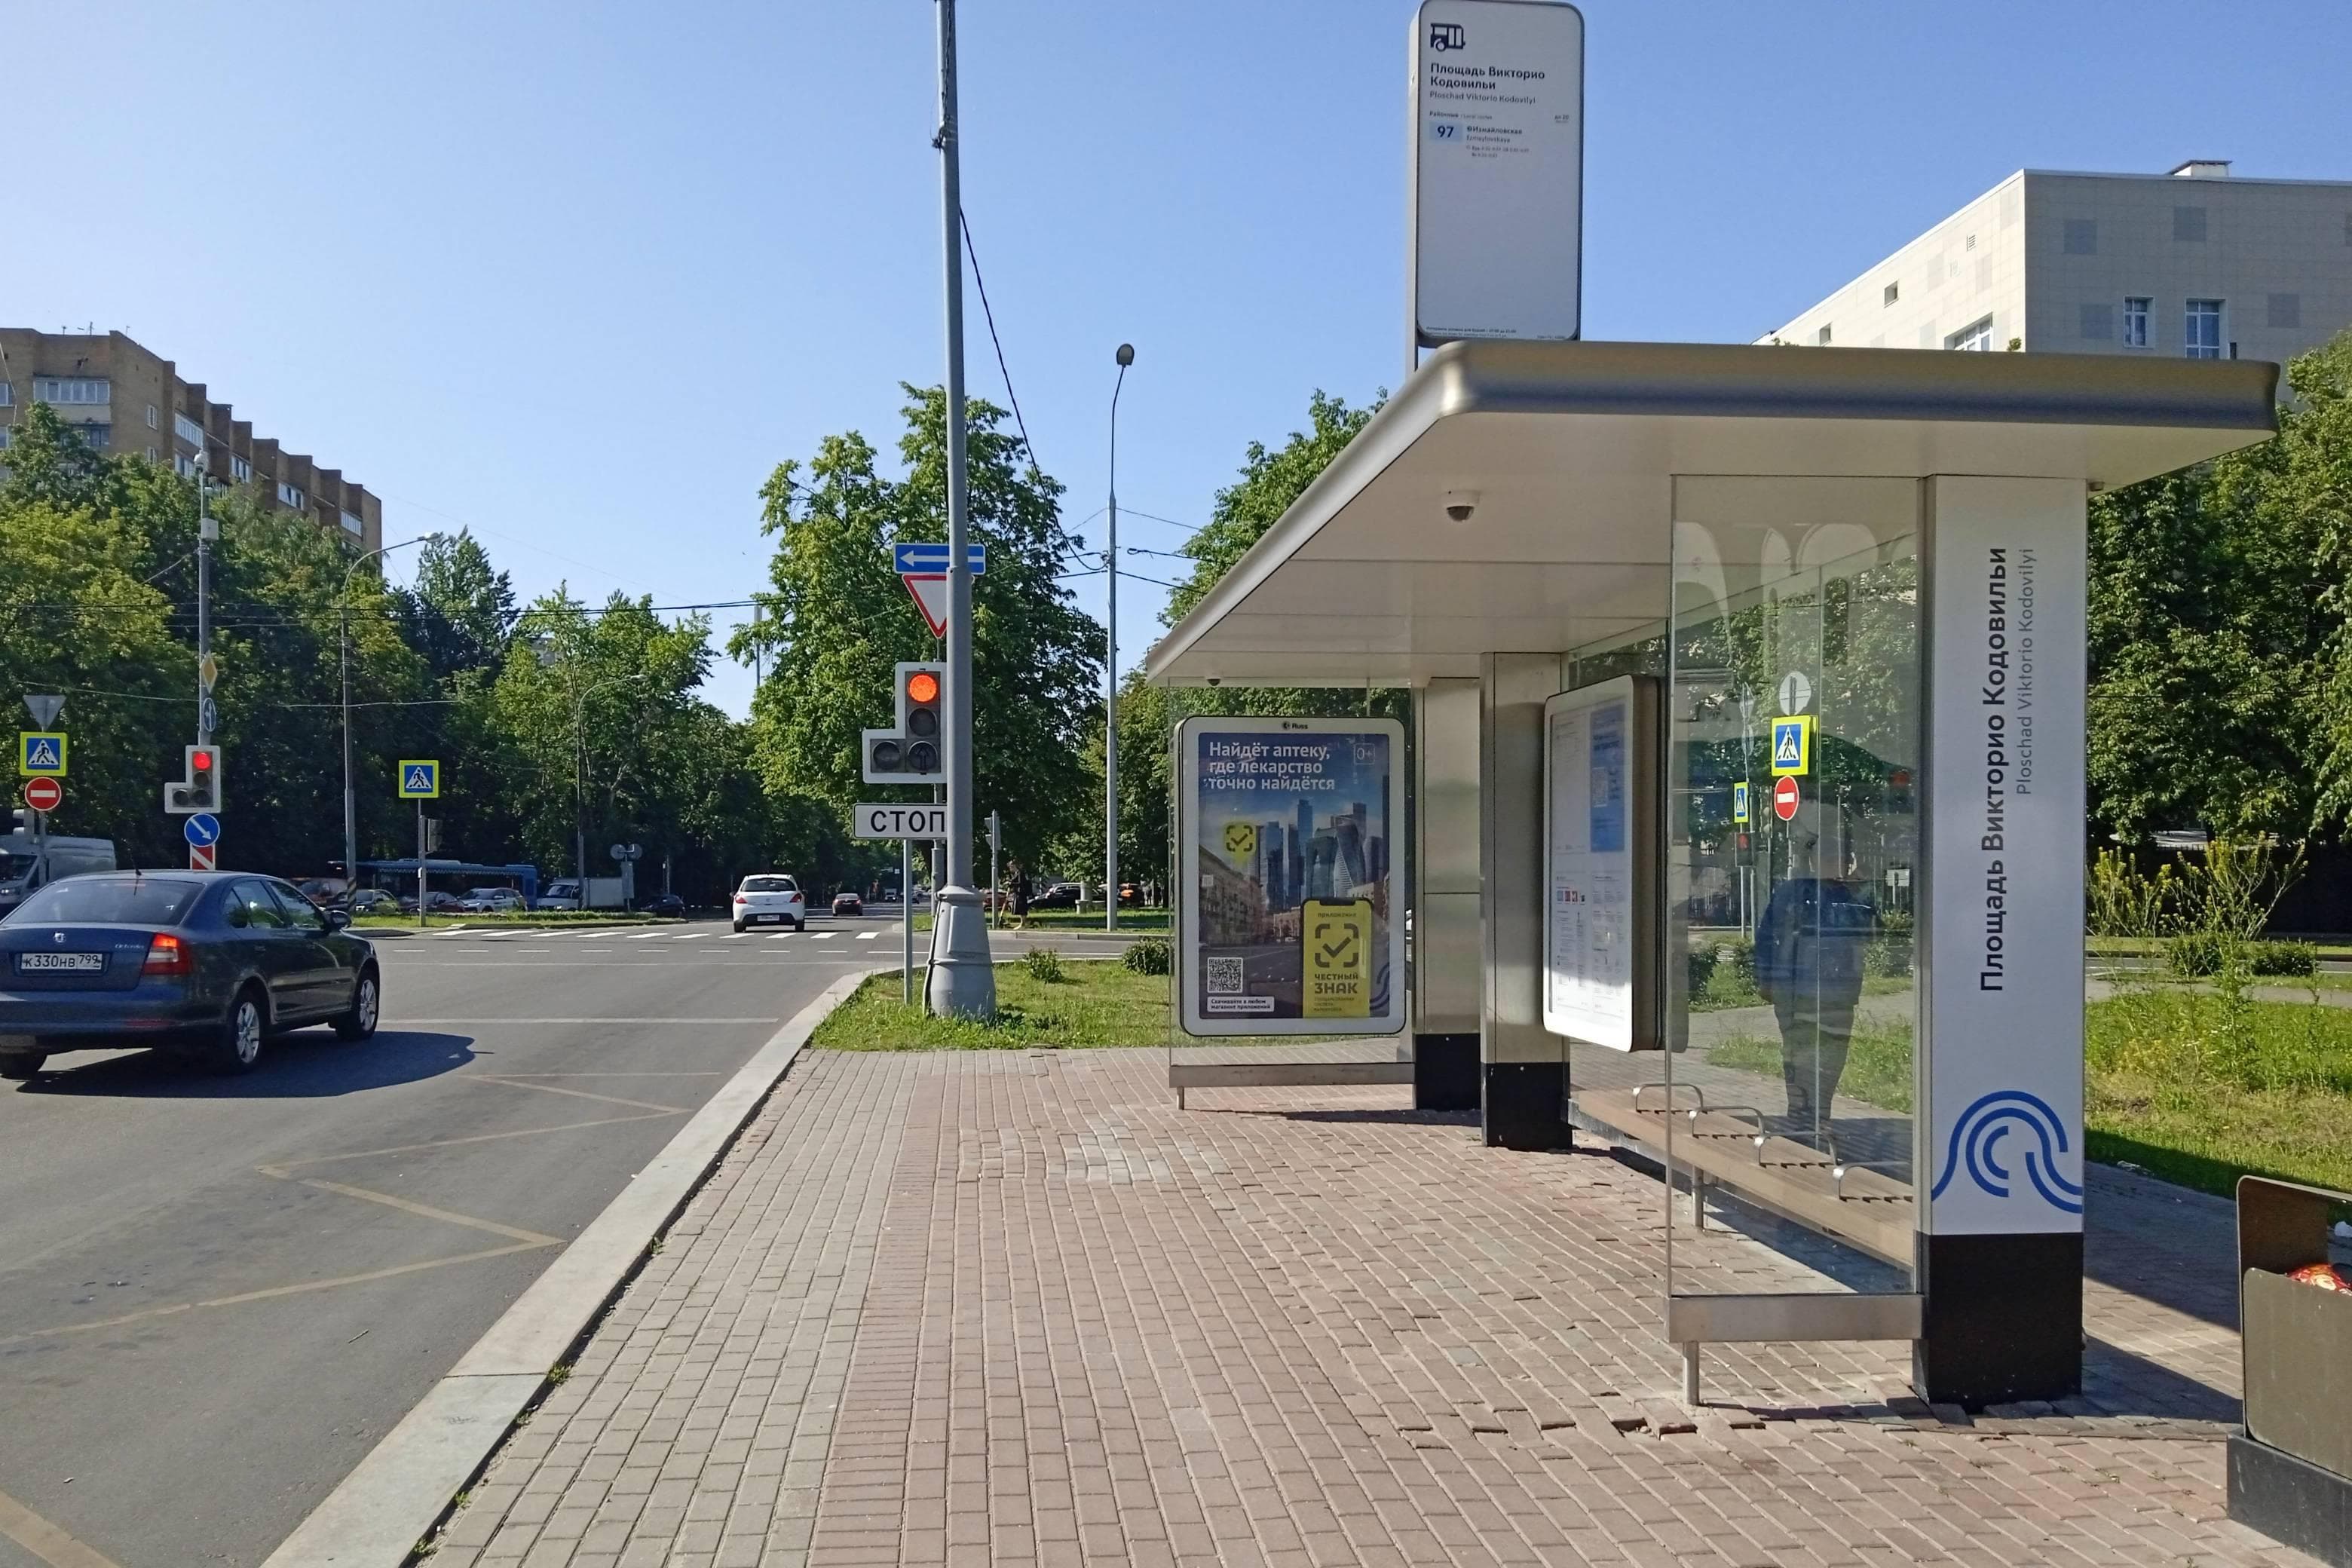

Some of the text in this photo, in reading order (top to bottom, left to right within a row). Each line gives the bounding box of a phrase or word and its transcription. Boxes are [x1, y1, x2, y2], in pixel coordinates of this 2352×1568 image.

[1430, 63, 1545, 81] Площадь Викторио
[1430, 77, 1496, 90] Кодовильи
[1429, 91, 1536, 105] Ploschad Viktorio Kodovilyi
[1437, 125, 1454, 138] 97
[2016, 548, 2037, 795] Ploschad Viktorio Kodovilyi
[1209, 741, 1330, 761] Найдёт аптеку,
[1356, 747, 1372, 761] 0+
[1209, 762, 1322, 776] где лекарство
[1980, 547, 2010, 991] Площадь Викторио Кодовильи
[1210, 776, 1335, 792] точно найдётся
[871, 810, 945, 832] СТОП
[78, 954, 98, 964] 799
[1315, 972, 1358, 980] ЧЕСТНЫЙ
[1315, 982, 1358, 994] ЗНАК
